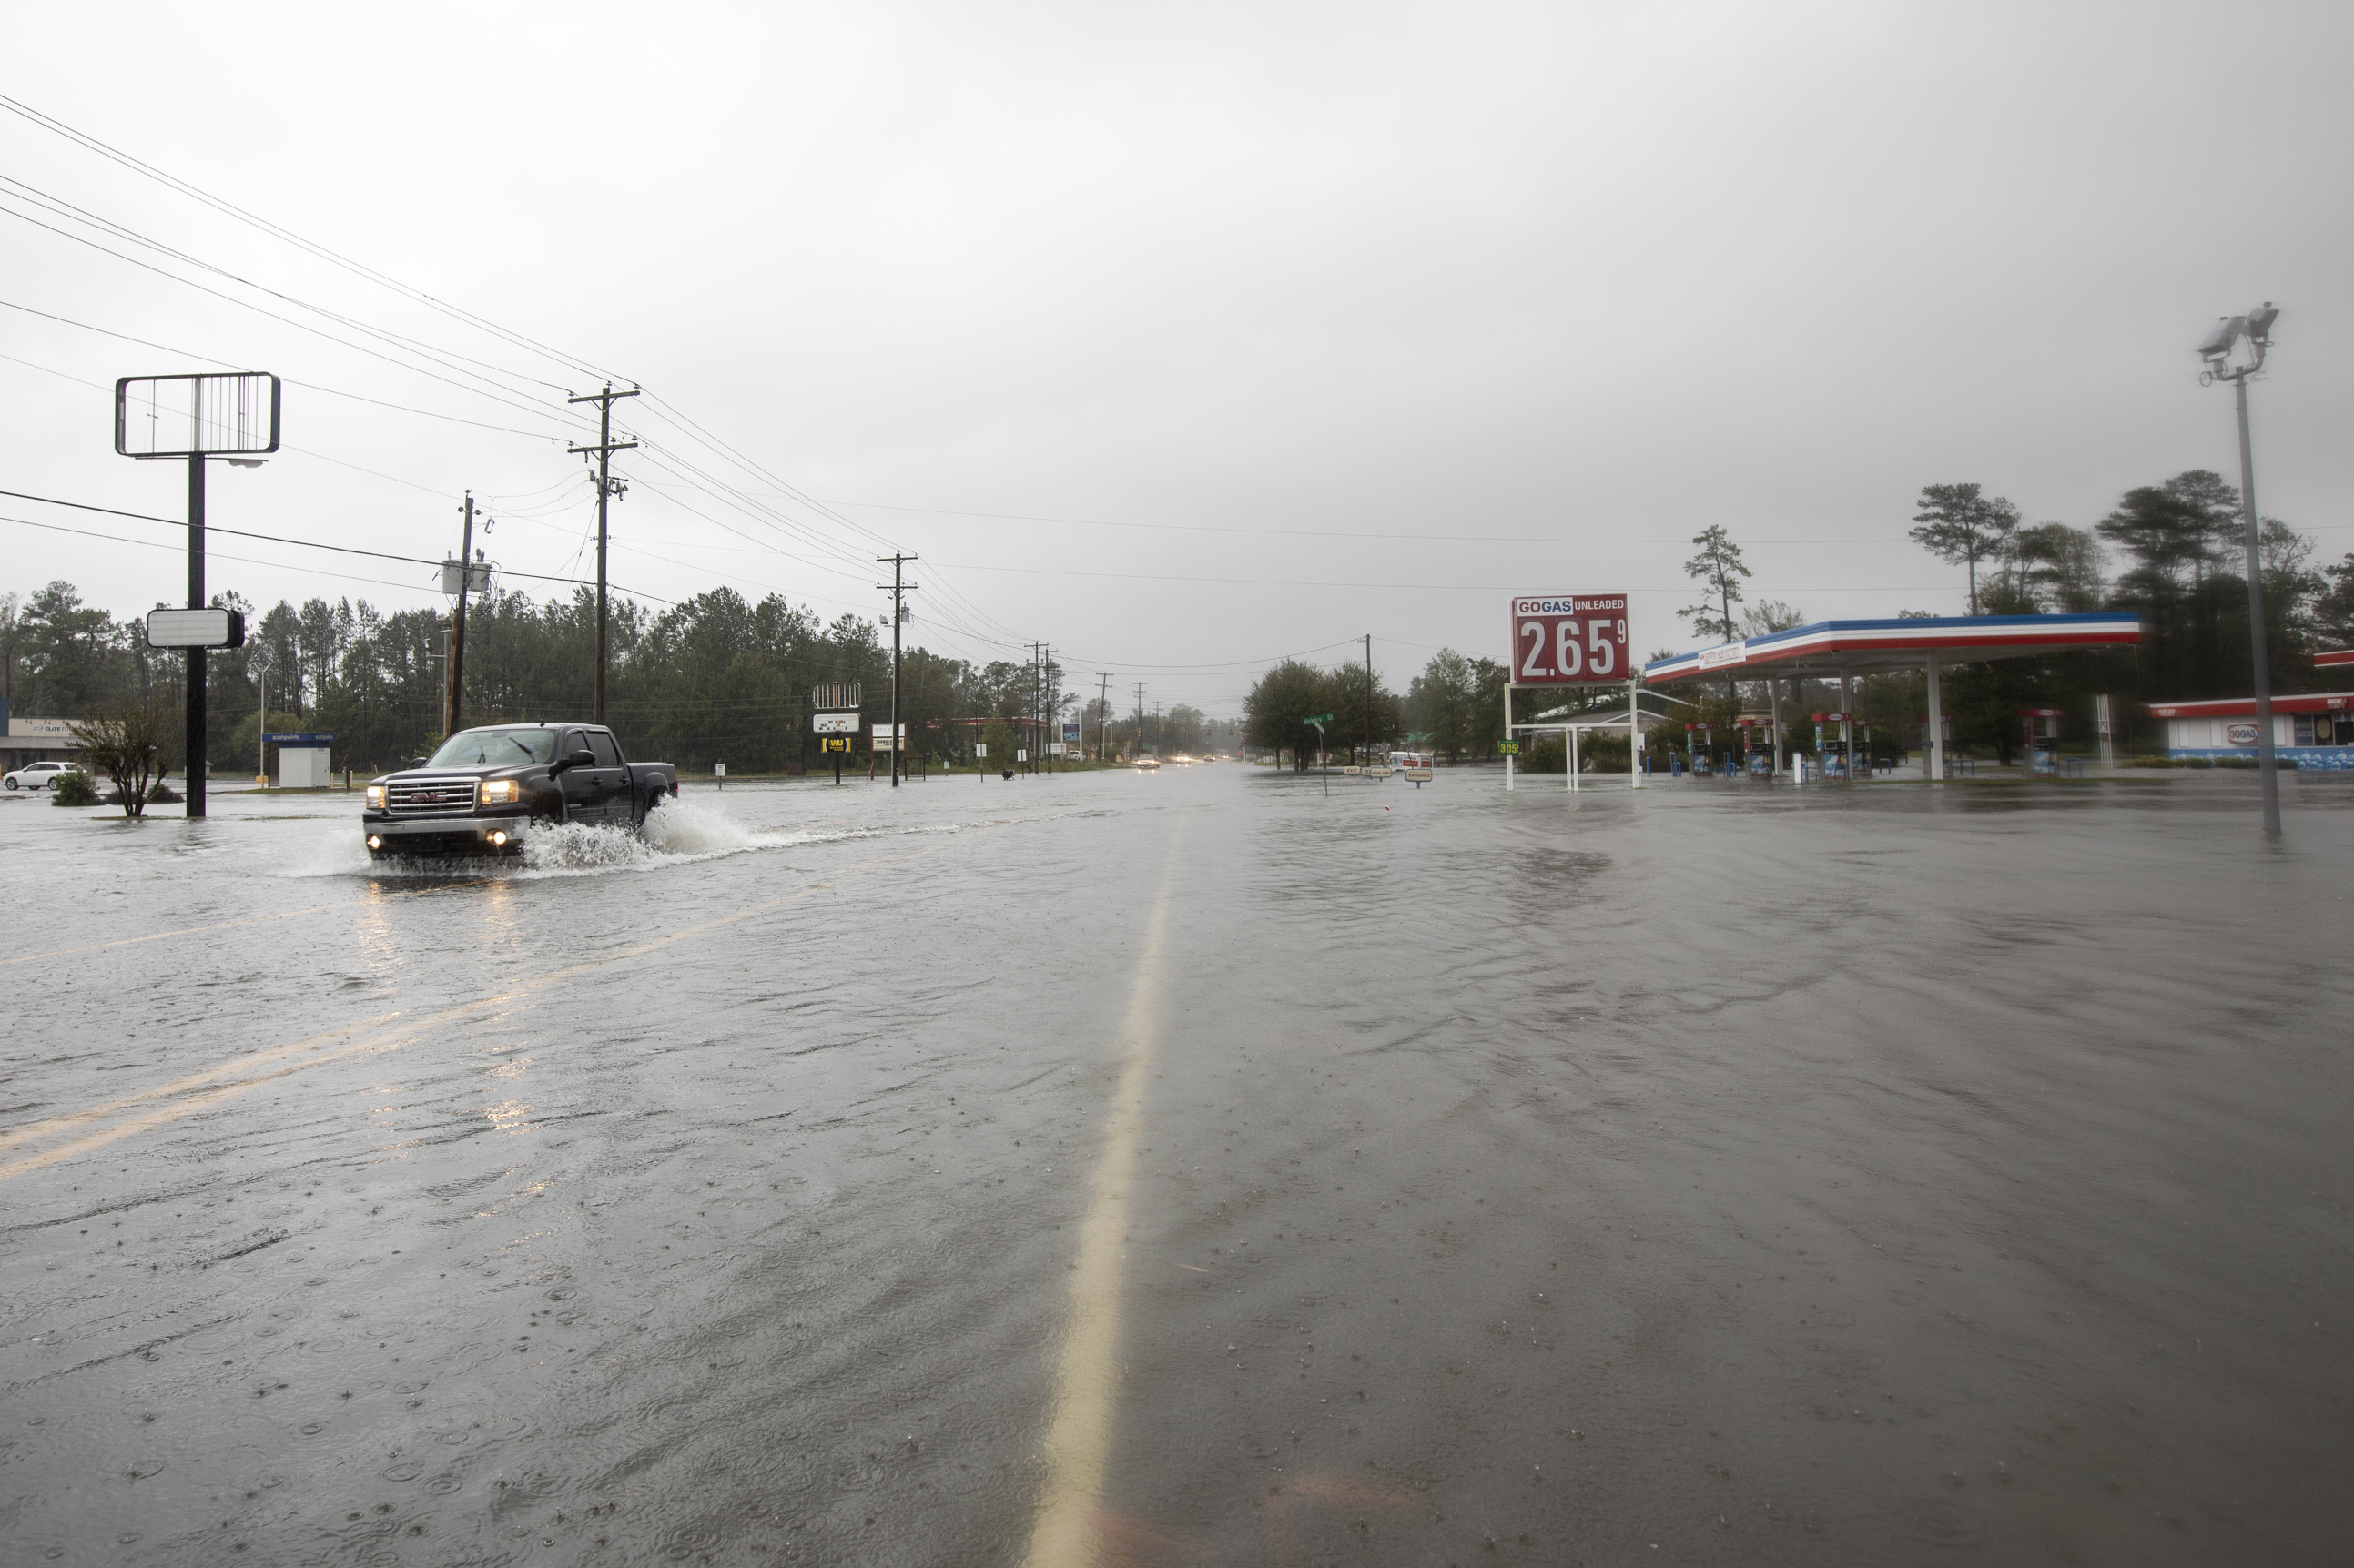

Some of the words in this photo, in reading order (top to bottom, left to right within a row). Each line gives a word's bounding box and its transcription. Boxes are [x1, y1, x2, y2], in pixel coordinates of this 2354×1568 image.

[1518, 601, 1572, 613] GOGAS
[1574, 599, 1624, 611] UNLEADED
[1303, 717, 1323, 725] Hickory
[2229, 728, 2257, 739] GOGAS
[410, 791, 447, 802] GMC
